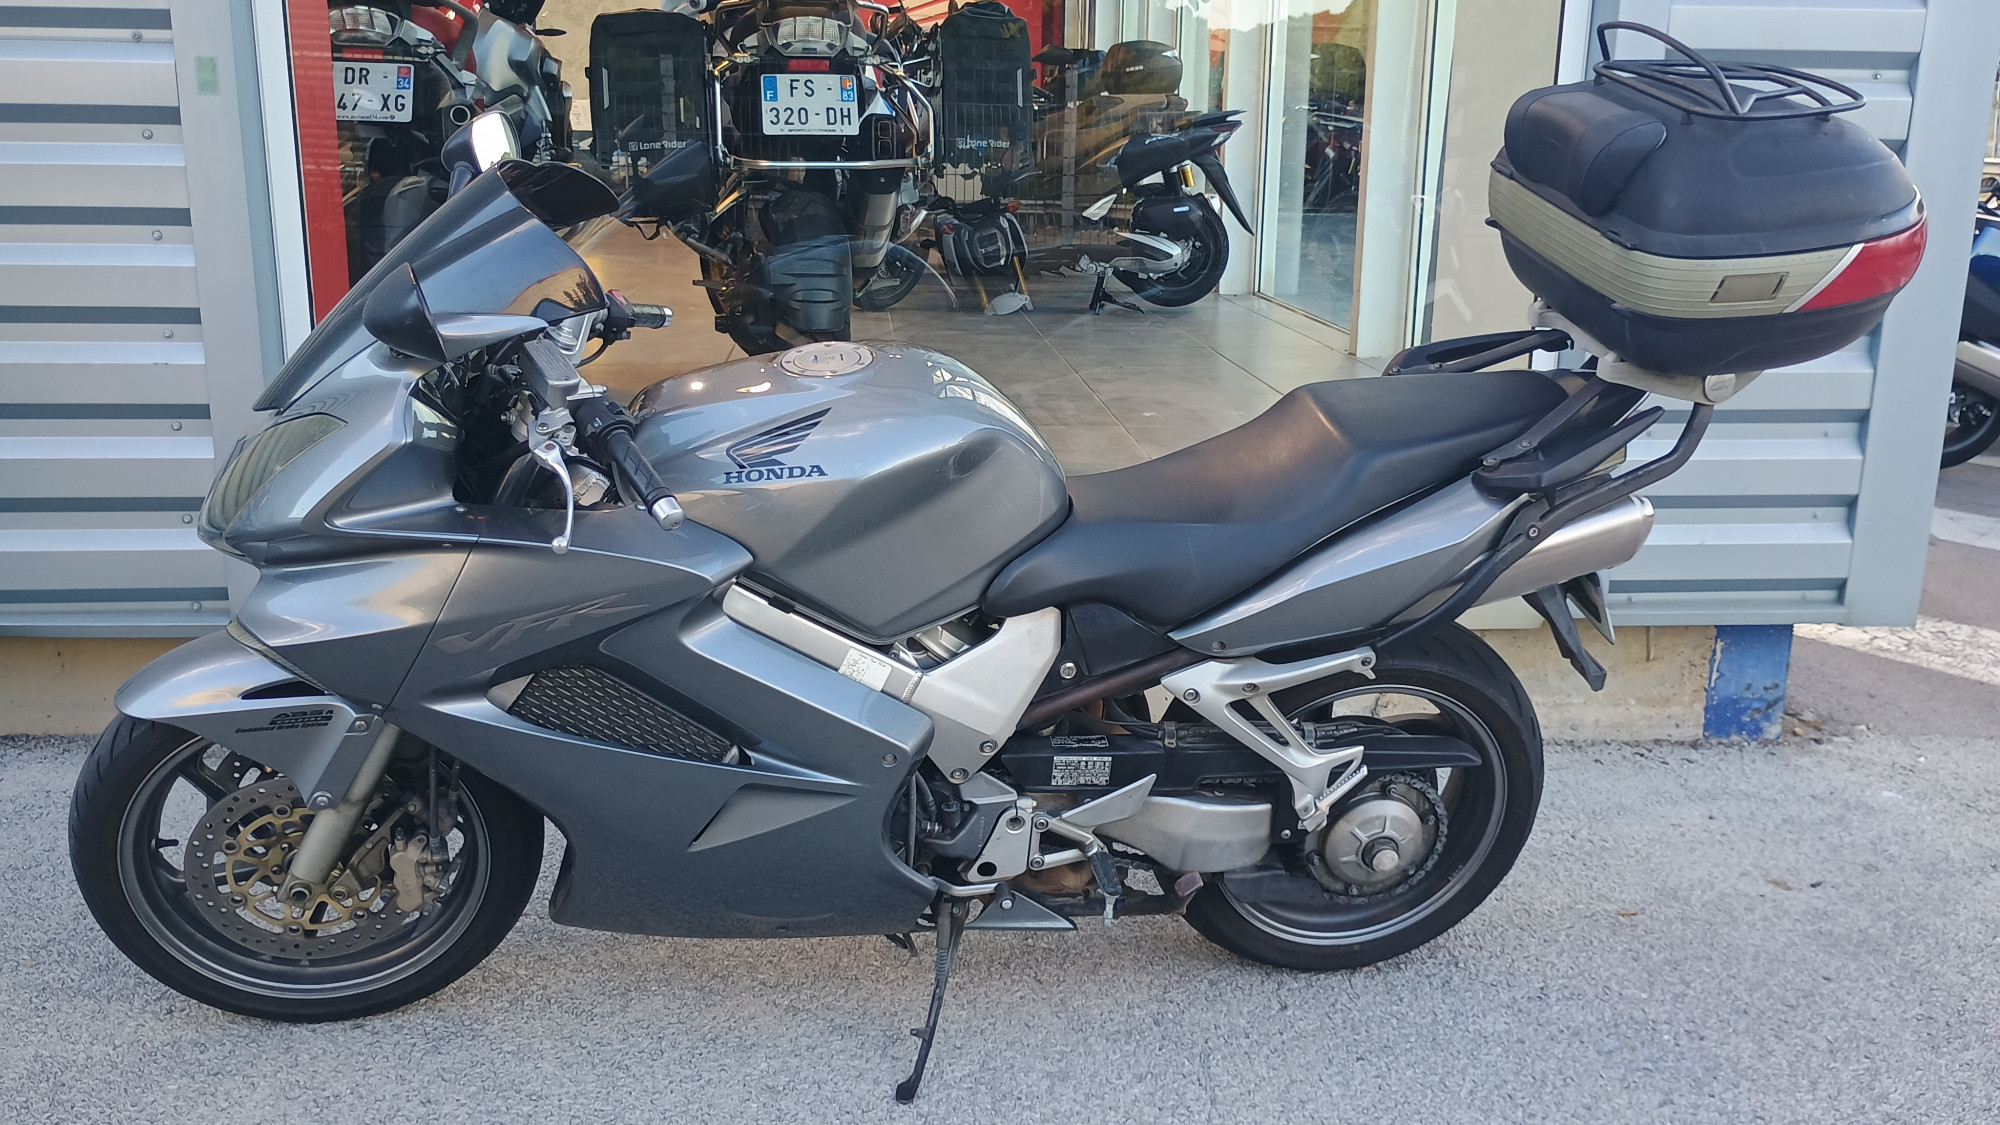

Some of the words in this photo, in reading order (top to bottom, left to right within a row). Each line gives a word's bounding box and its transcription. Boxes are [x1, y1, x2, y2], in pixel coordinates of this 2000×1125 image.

[344, 67, 370, 85] DR
[397, 78, 410, 89] 34
[789, 79, 815, 98] FS
[766, 91, 774, 100] F
[842, 91, 854, 101] 83
[662, 139, 687, 149] Rider
[723, 464, 828, 485] HONDA
[433, 592, 650, 655] VFR
